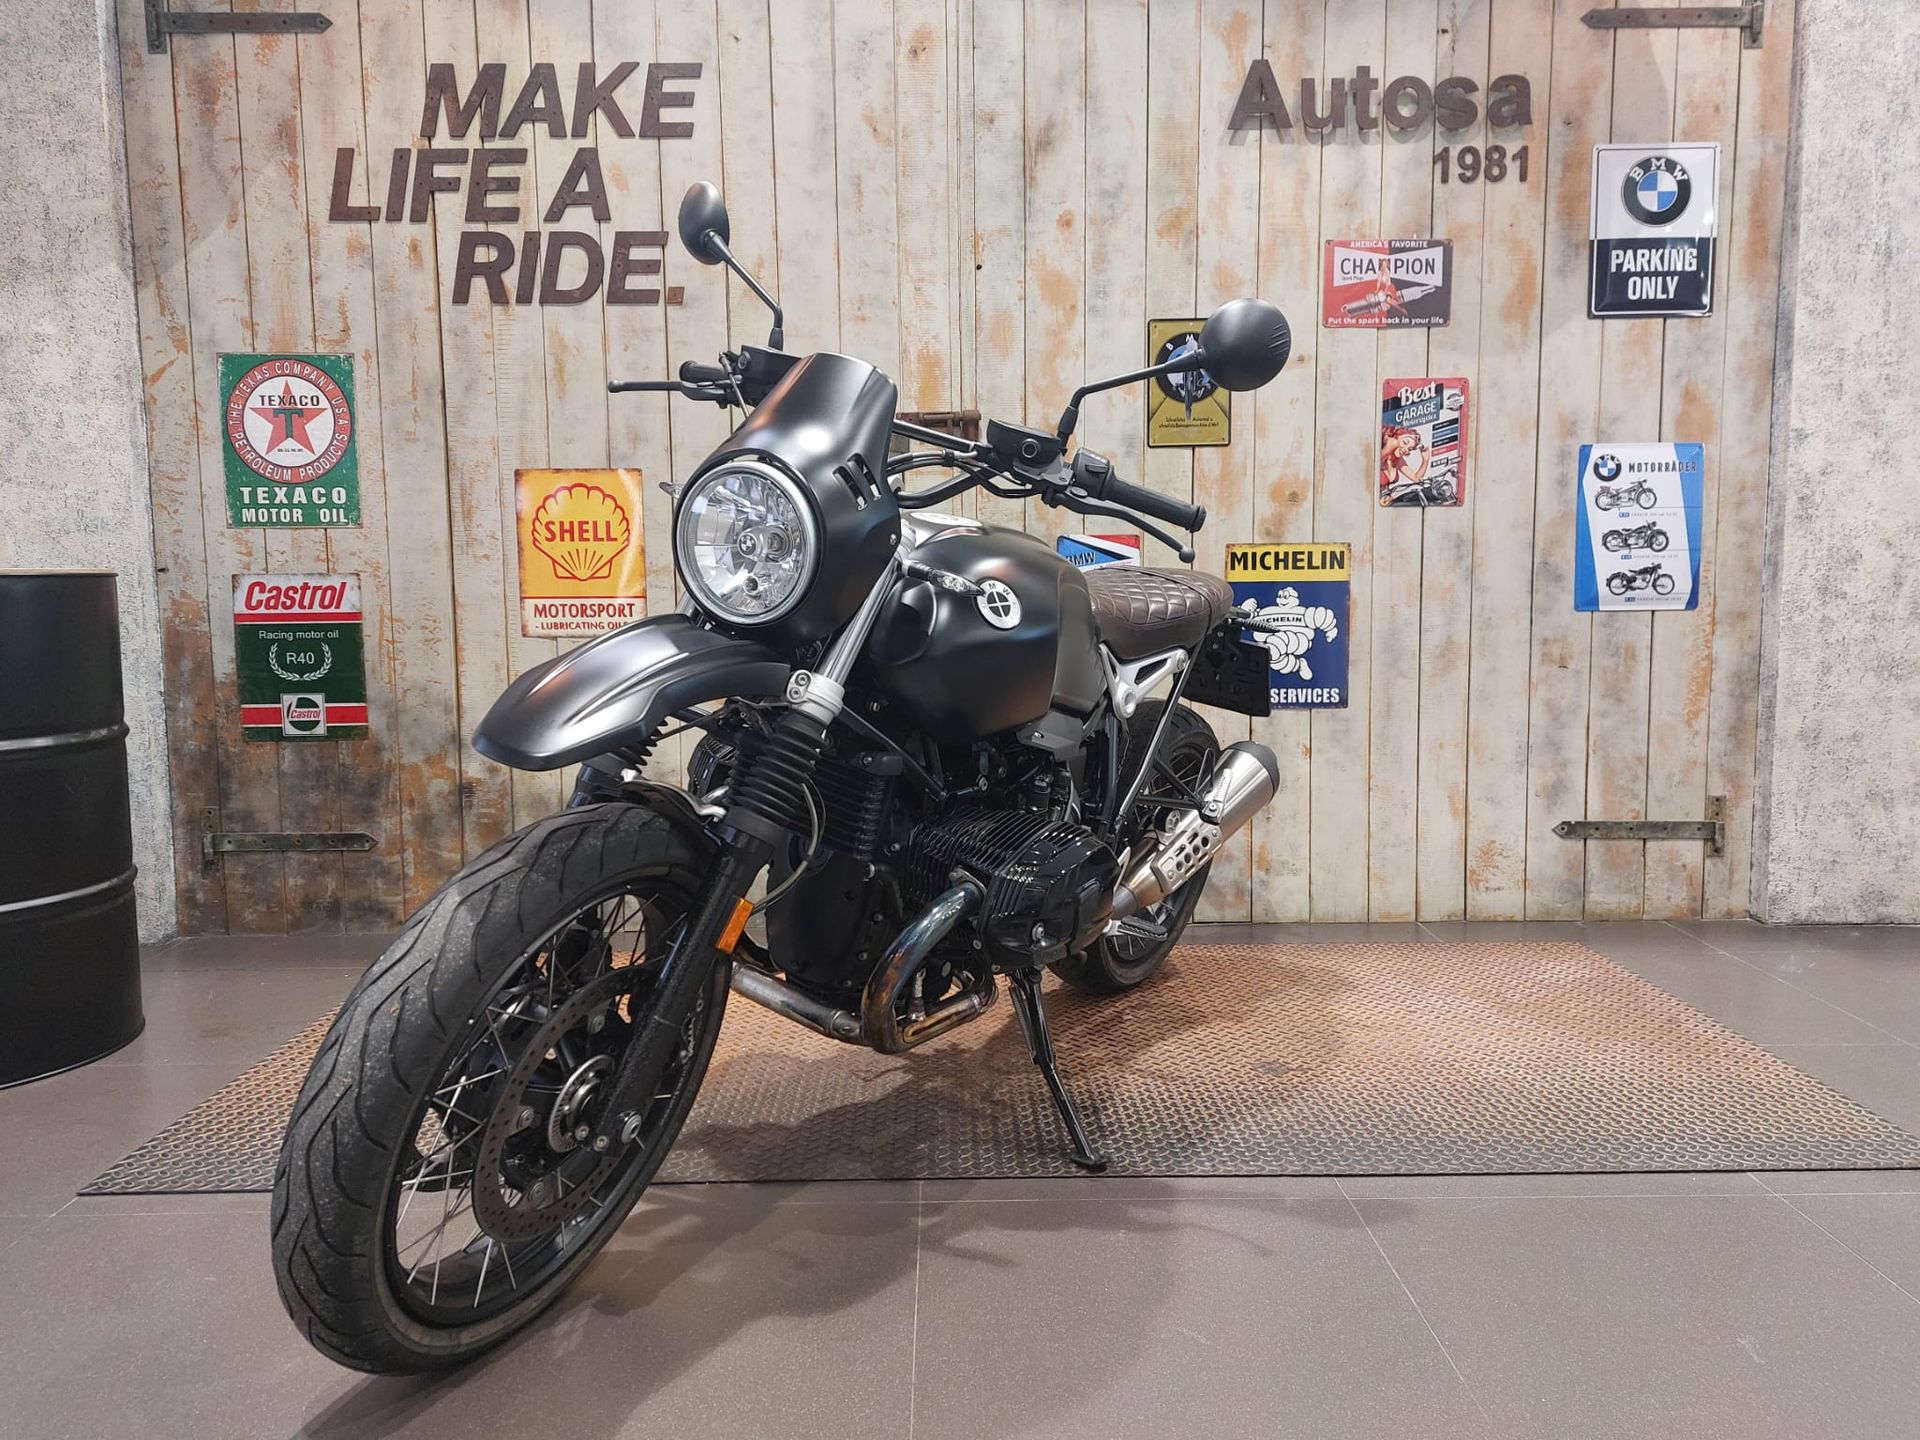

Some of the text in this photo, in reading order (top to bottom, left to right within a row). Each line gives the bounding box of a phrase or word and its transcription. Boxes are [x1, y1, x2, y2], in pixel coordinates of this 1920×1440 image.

[420, 62, 703, 138] MAKE
[1227, 59, 1533, 130] Autosa
[1433, 144, 1529, 184] 1981
[1629, 157, 1689, 182] BMW
[329, 147, 611, 222] LIFE A
[1350, 240, 1428, 248] AMERICA'S FAVORITE
[452, 231, 685, 304] RIDE.
[1610, 248, 1698, 273] PARKING
[1627, 275, 1679, 301] ONLY
[1328, 316, 1444, 326] Put the spark back in your life
[235, 366, 270, 397] TEXAS
[275, 361, 335, 392] COMPANY
[259, 394, 320, 407] TEXACO
[1398, 381, 1437, 406] Best
[229, 401, 242, 426] THE
[272, 408, 304, 439] T
[1395, 401, 1438, 422] GARAGE
[231, 432, 348, 481] PETROLEUM PRODUCTS
[239, 486, 347, 505] TEXACO
[241, 507, 348, 523] MOTOR OIL
[544, 520, 618, 542] SHELL
[1230, 550, 1345, 571] MICHELIN
[244, 581, 347, 611] Castrol
[533, 603, 635, 619] MOTORSPORT
[259, 630, 339, 641] Racing motor oil
[541, 621, 605, 630] LUBRICATING
[286, 652, 315, 665] R40
[1270, 687, 1340, 704] SERVICES
[290, 708, 322, 719] Castrol
